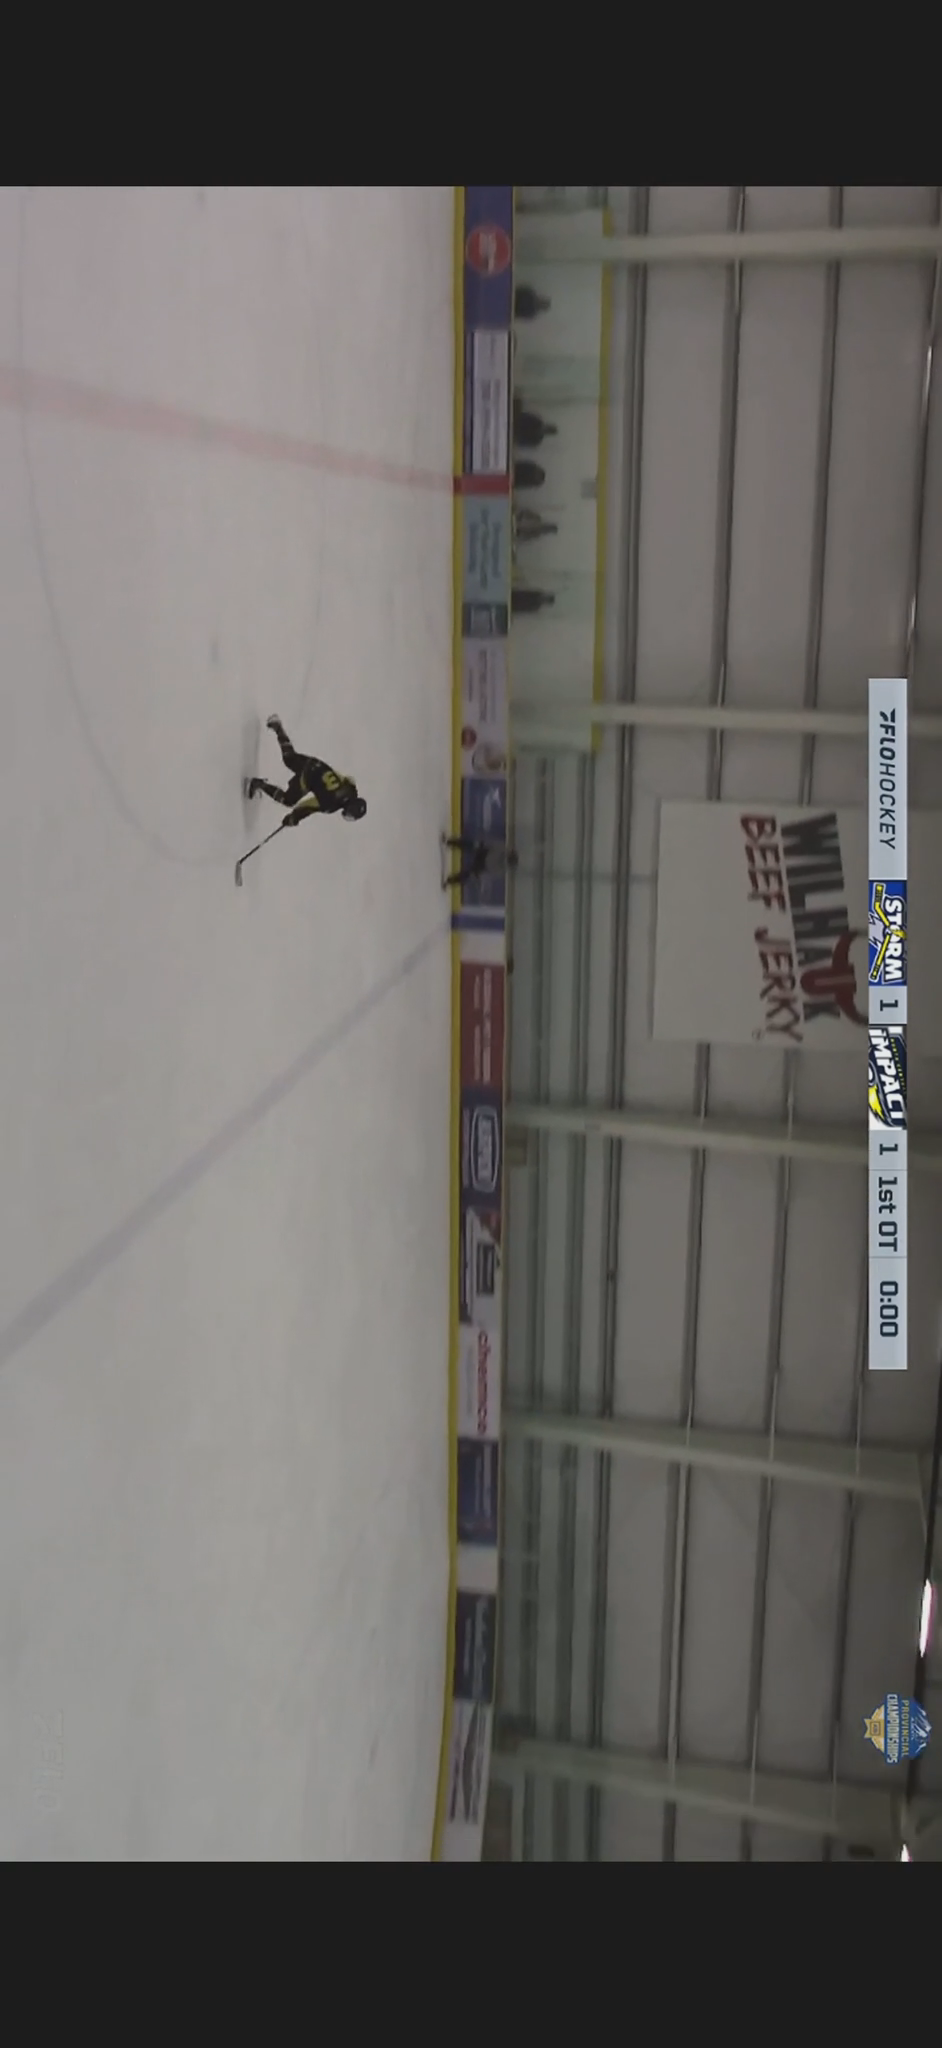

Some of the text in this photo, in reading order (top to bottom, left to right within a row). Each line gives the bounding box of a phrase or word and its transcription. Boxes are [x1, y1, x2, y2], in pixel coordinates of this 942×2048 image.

[741, 815, 804, 1042] BEEF JERKY
[781, 813, 856, 1022] WILHAUK
